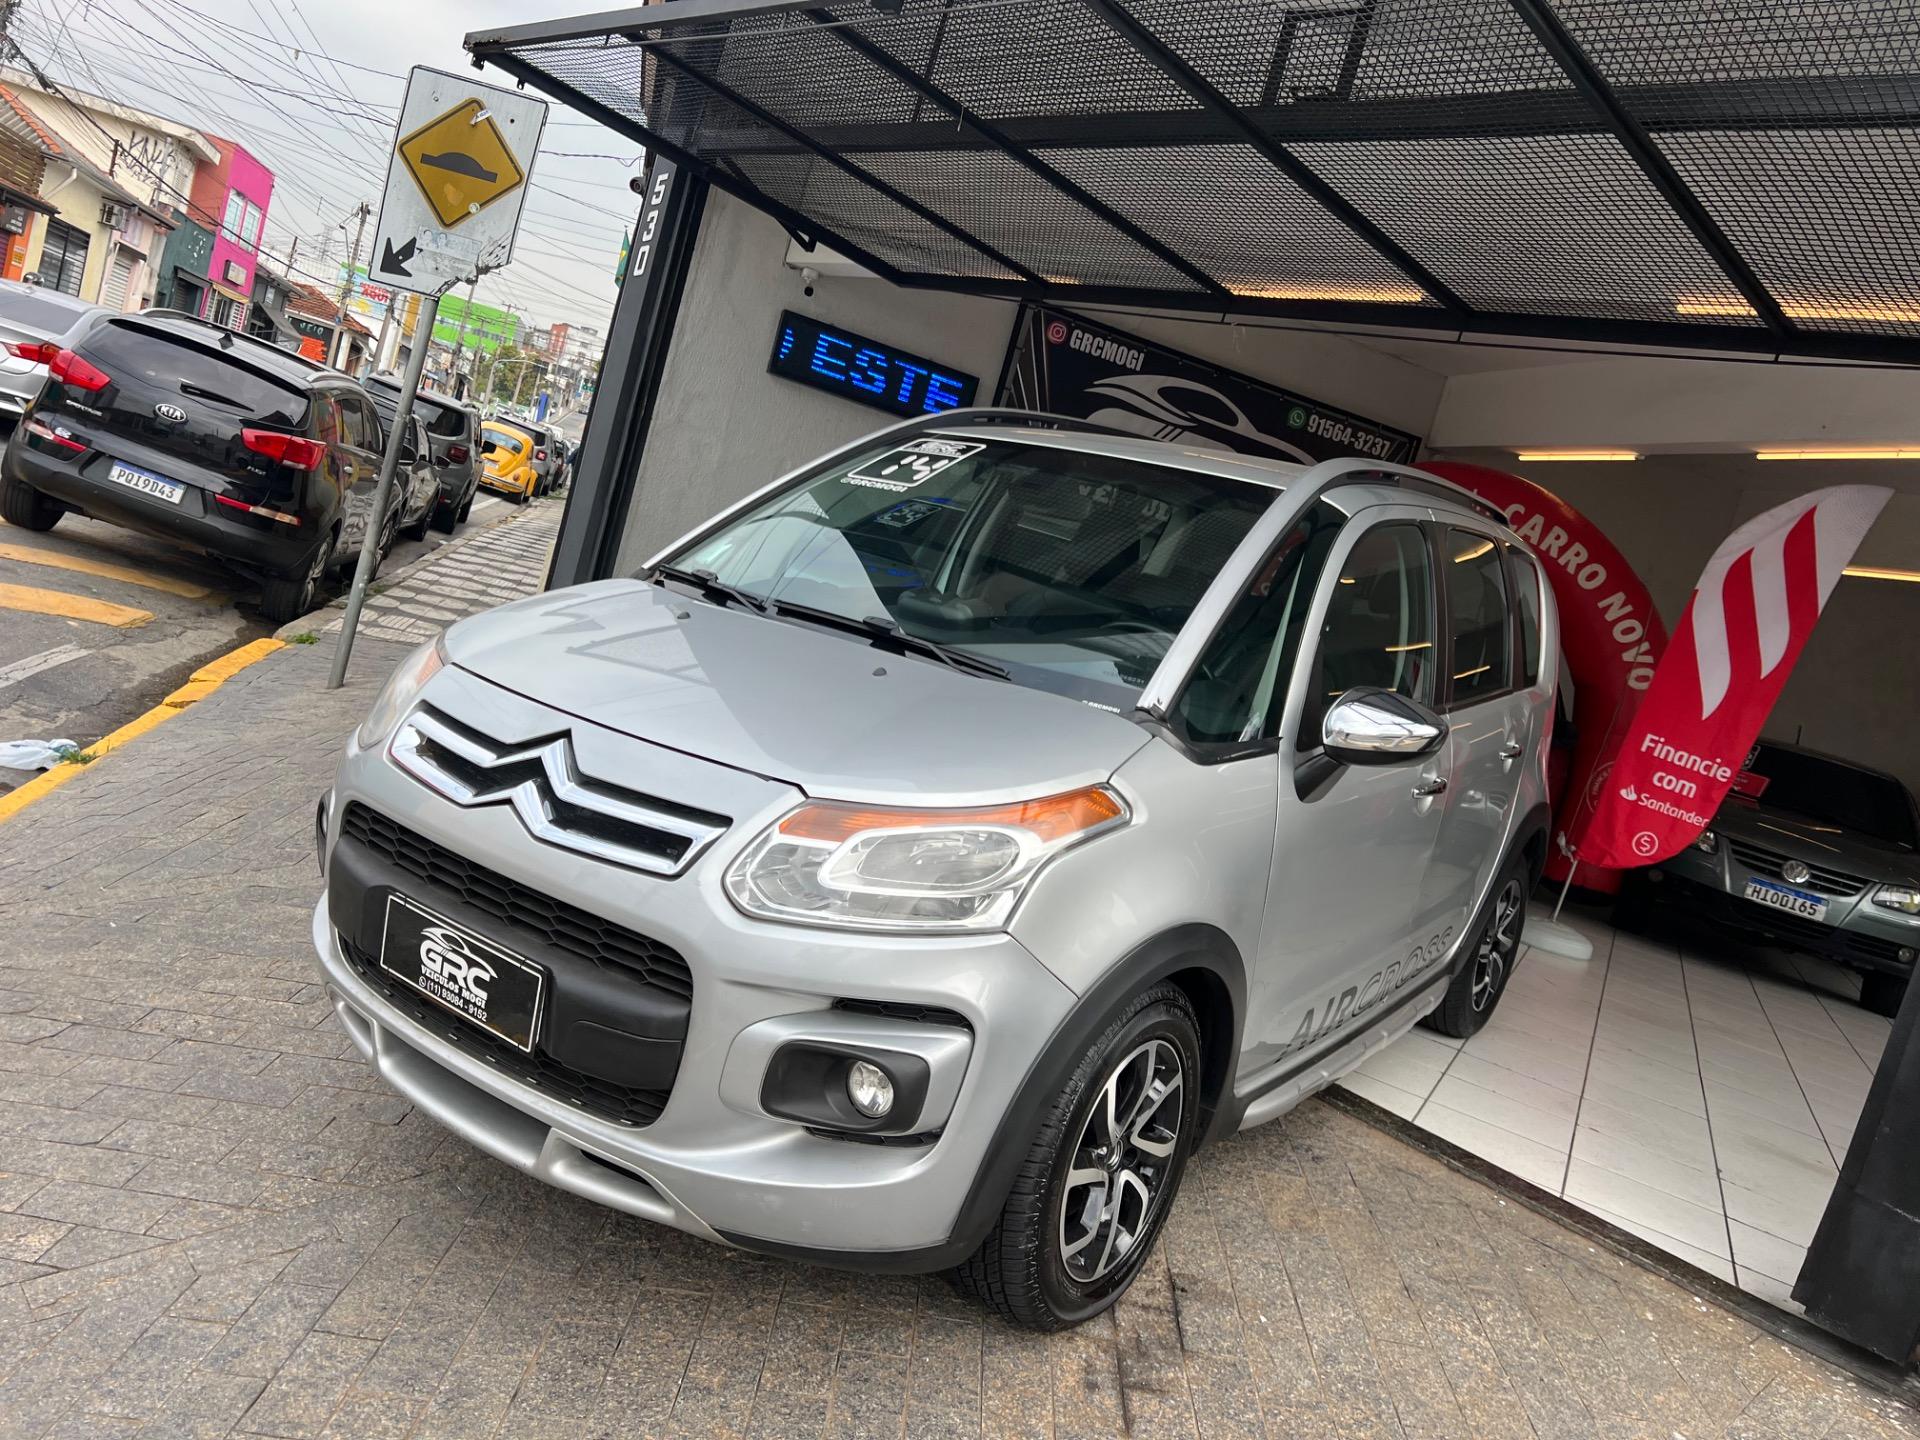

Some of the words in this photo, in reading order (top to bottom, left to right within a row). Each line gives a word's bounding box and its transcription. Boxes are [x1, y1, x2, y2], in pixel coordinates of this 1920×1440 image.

[633, 172, 670, 277] 530
[1069, 328, 1146, 372] GRCMOGI
[811, 333, 963, 414] ESTE
[159, 404, 184, 421] KIA
[1306, 413, 1393, 460] 91564-3237
[1503, 503, 1607, 590] CARRO
[1597, 591, 1655, 690] NOVO
[1640, 733, 1732, 782] Financie
[1652, 771, 1697, 799] com
[1638, 792, 1710, 828] Santander
[420, 939, 491, 1001] GRC
[420, 964, 460, 994] VEICULOS
[461, 988, 487, 1010] MOGI
[427, 980, 442, 997] (11)
[468, 1004, 488, 1022] 9152
